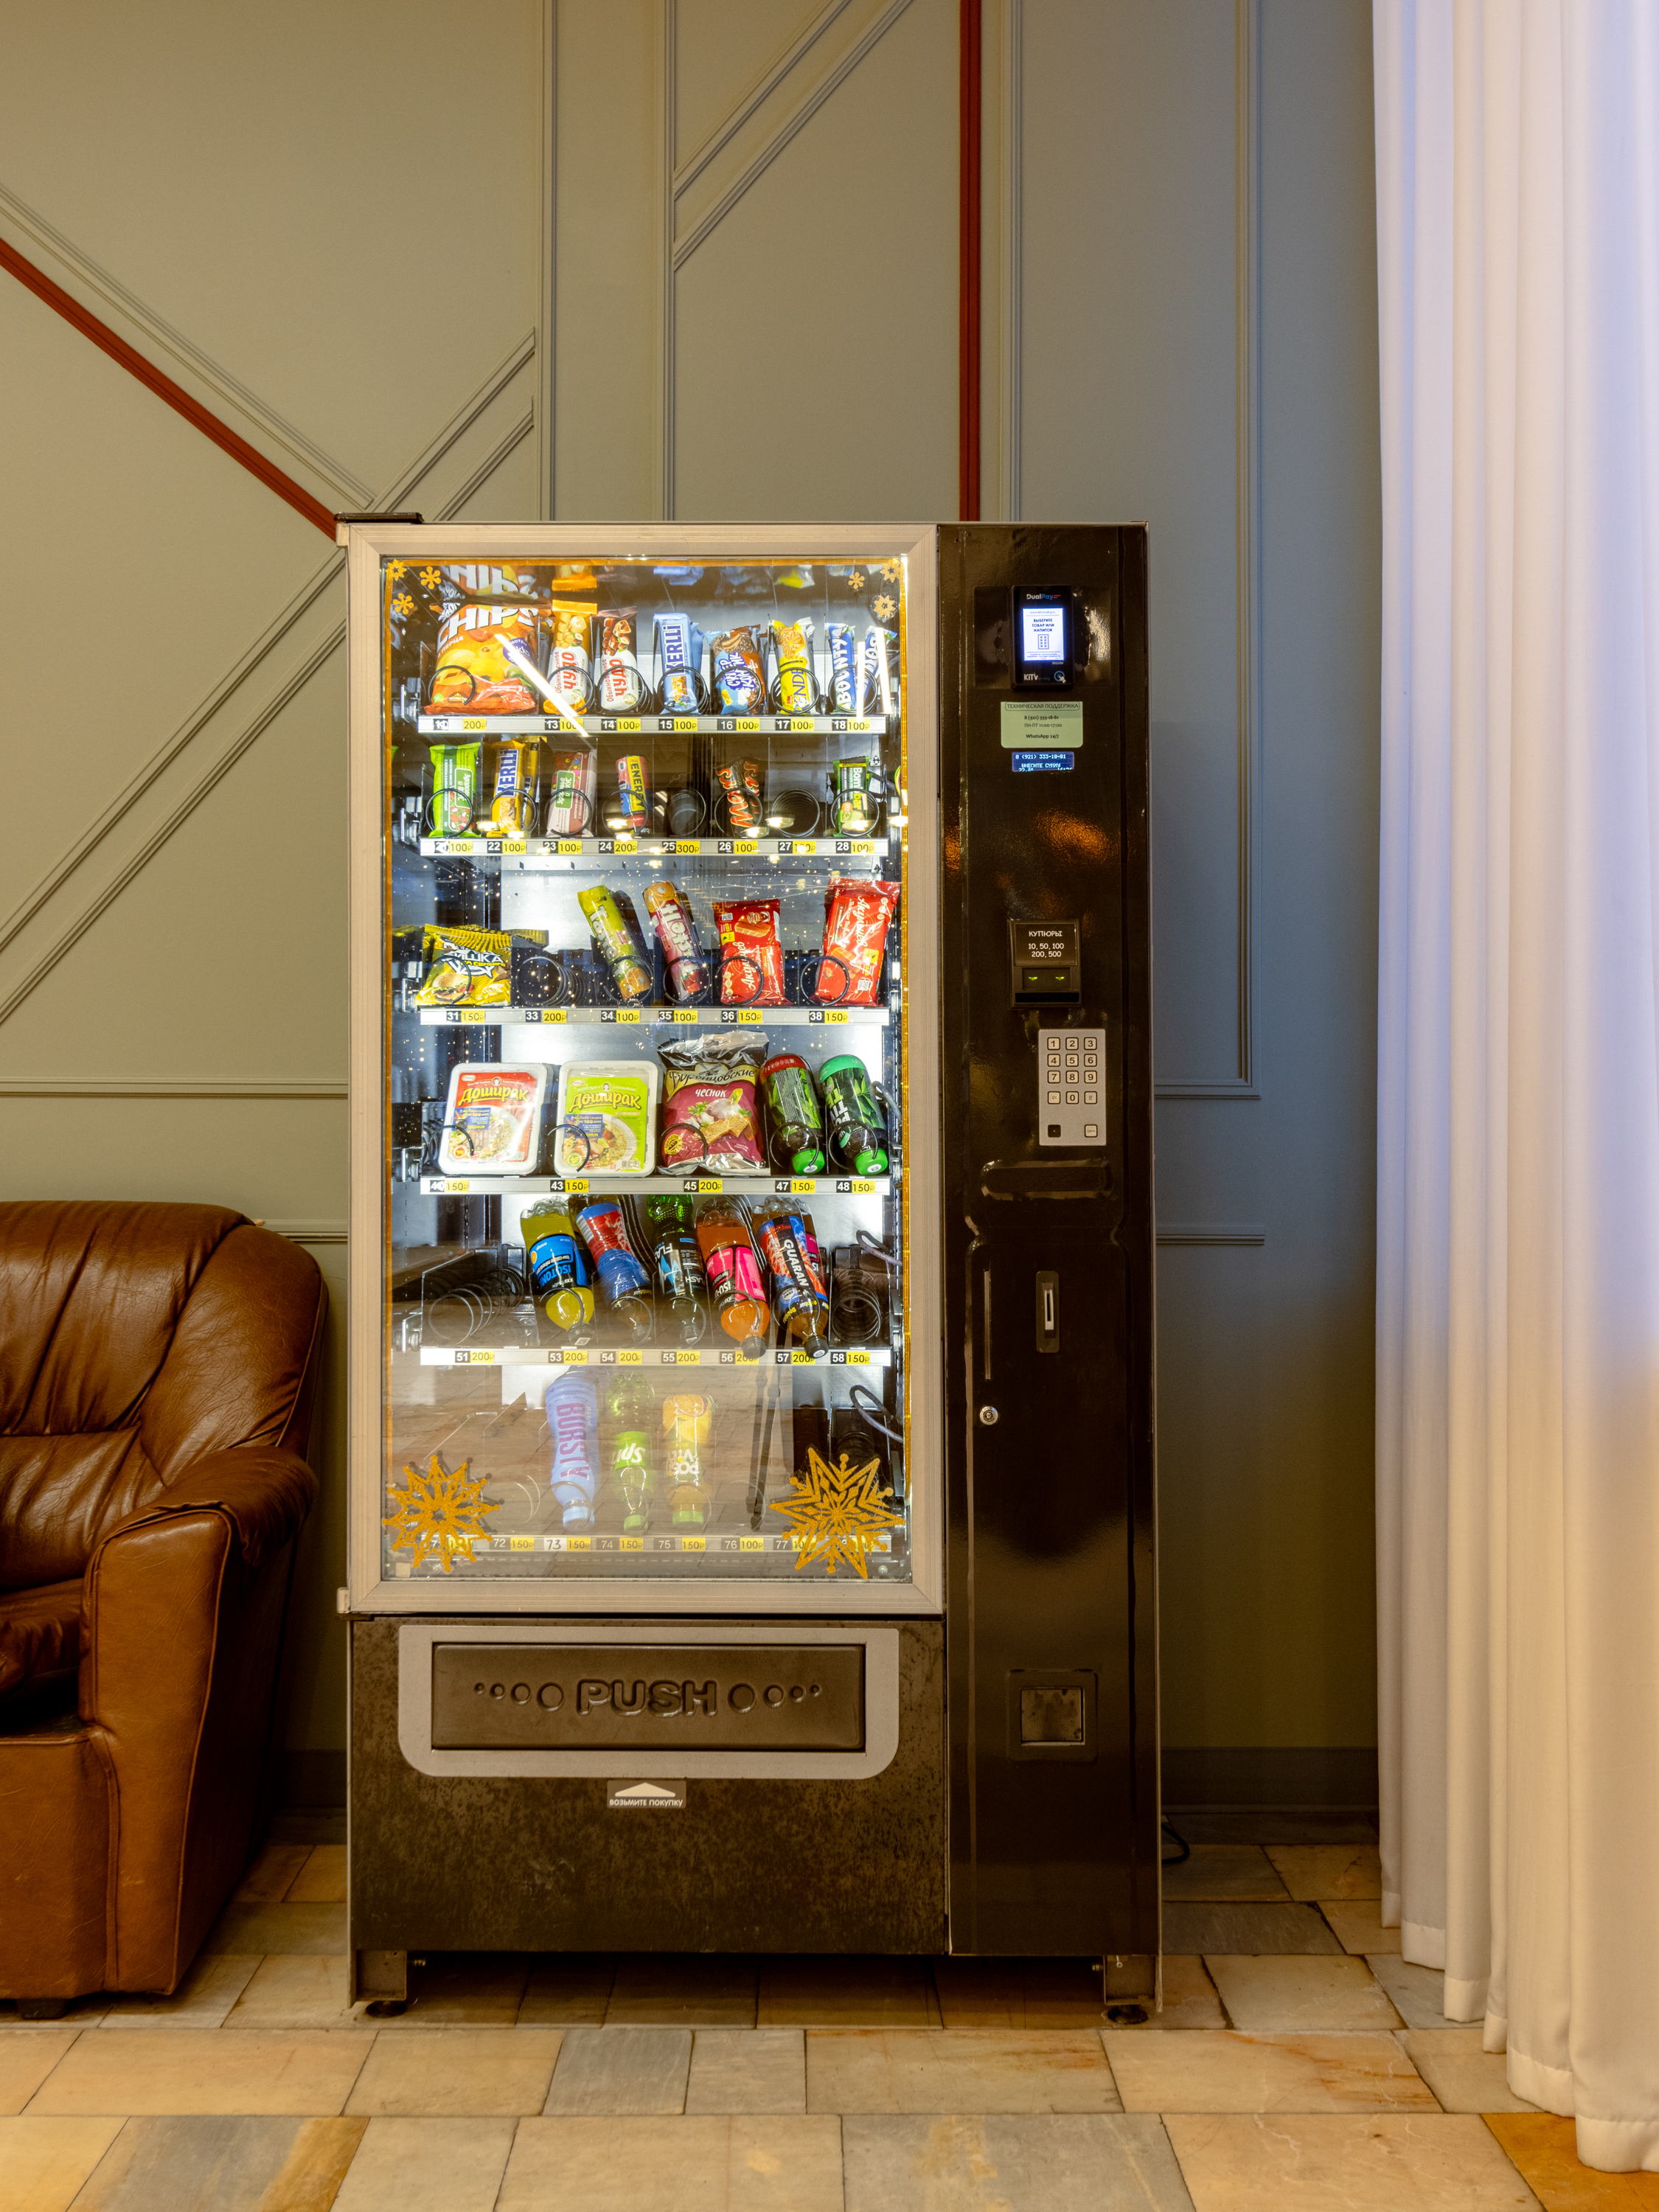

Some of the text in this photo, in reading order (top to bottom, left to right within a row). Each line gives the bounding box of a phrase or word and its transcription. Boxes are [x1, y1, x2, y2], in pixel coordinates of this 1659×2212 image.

[546, 720, 558, 729] 13
[602, 720, 615, 729] 14
[660, 720, 672, 729] 15
[721, 720, 733, 730] 16
[776, 720, 790, 729] 17
[833, 720, 846, 729] 18
[487, 842, 501, 851] 22
[544, 842, 556, 851] 23
[599, 842, 612, 850] 24
[663, 842, 675, 850] 25
[719, 842, 731, 851] 26
[779, 842, 791, 851] 27
[837, 842, 849, 851] 28
[447, 1012, 458, 1020] 31
[602, 1012, 613, 1020] 34
[659, 1012, 672, 1020] 35
[722, 1012, 734, 1020] 36
[810, 1012, 822, 1020] 38
[458, 1085, 529, 1107] Доширак
[695, 1088, 727, 1097] ЧЕСНОК
[568, 1092, 641, 1113] Доширак
[551, 1181, 564, 1190] 43
[684, 1181, 697, 1190] 45
[776, 1182, 789, 1191] 47
[837, 1182, 850, 1191] 48
[456, 1352, 469, 1361] 51
[549, 1352, 562, 1361] 53
[602, 1353, 613, 1362] 54
[663, 1353, 675, 1362] 55
[721, 1353, 733, 1362] 56
[777, 1353, 789, 1362] 57
[832, 1353, 844, 1362] 58
[557, 1402, 590, 1478] BURSTY
[493, 1539, 506, 1548] 72
[546, 1540, 561, 1550] 73
[601, 1540, 613, 1549] 74
[658, 1540, 671, 1549] 75
[725, 1540, 737, 1549] 76
[776, 1540, 788, 1549] 77
[577, 1679, 718, 1717] PUSH
[610, 1798, 683, 1807] ВОЗЬМИТЕ ПОКУПКУ
